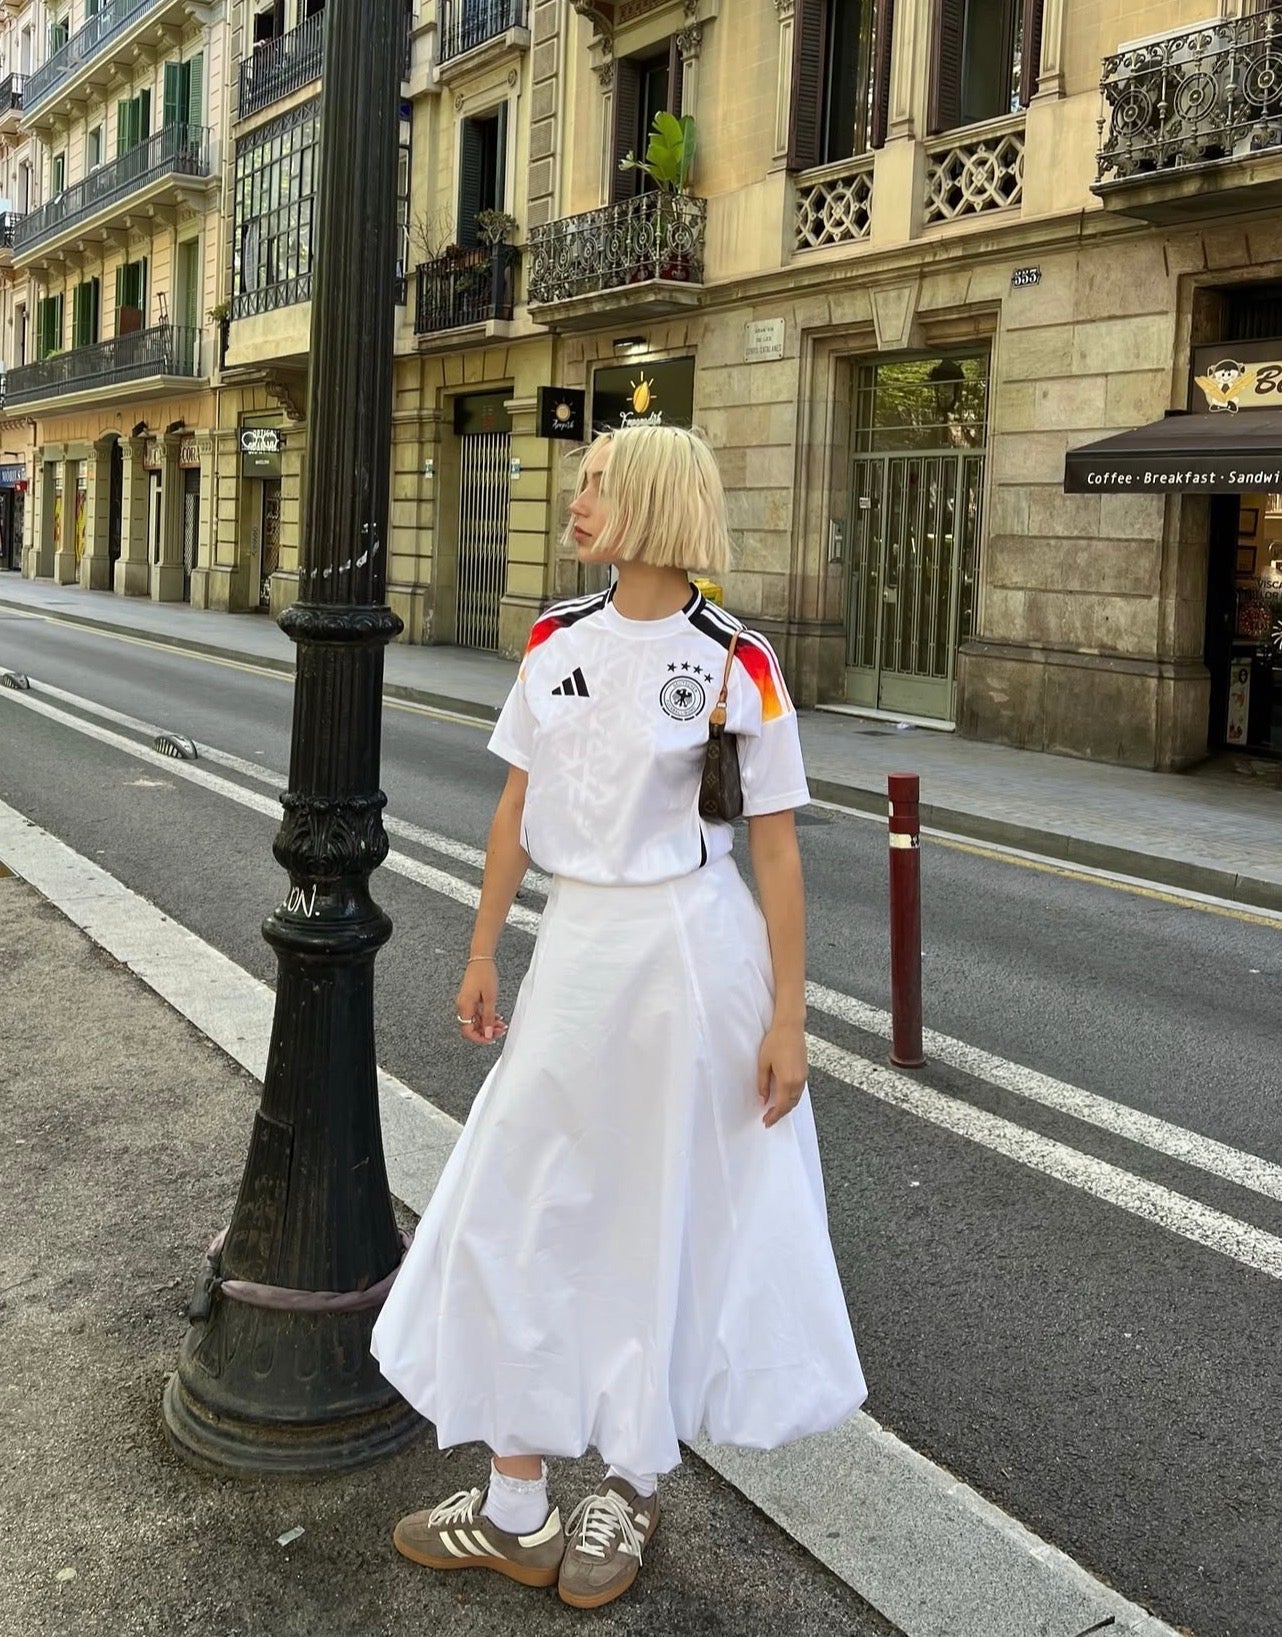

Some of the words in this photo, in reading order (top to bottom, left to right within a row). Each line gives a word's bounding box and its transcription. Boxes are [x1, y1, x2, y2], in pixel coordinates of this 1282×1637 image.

[1014, 268, 1037, 285] 553
[1087, 472, 1133, 485] Coffee
[1143, 471, 1217, 485] Breakfast
[1228, 470, 1281, 484] Sandwi
